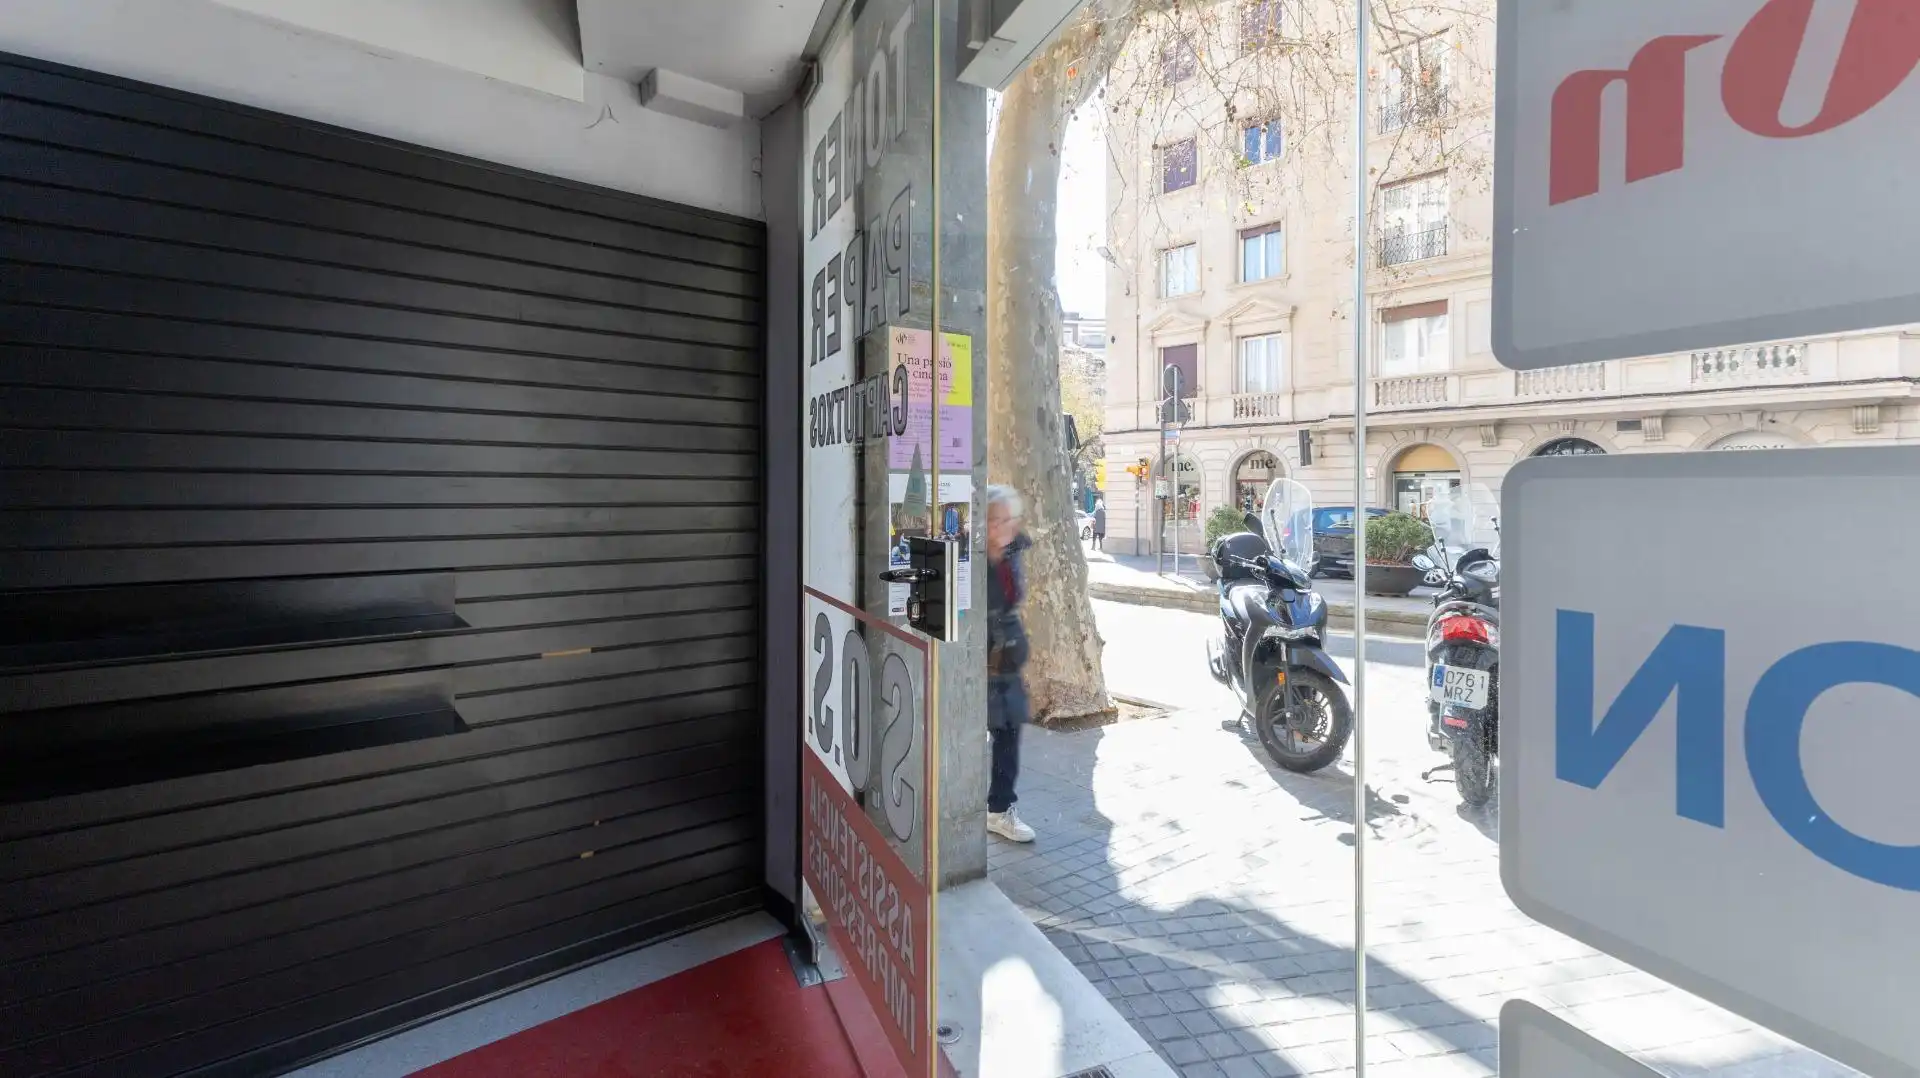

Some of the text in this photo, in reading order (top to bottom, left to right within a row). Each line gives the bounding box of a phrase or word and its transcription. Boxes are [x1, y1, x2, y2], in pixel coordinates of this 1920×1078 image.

[896, 352, 920, 366] Una
[1445, 670, 1485, 689] 0761
[1443, 685, 1474, 703] MRZ
